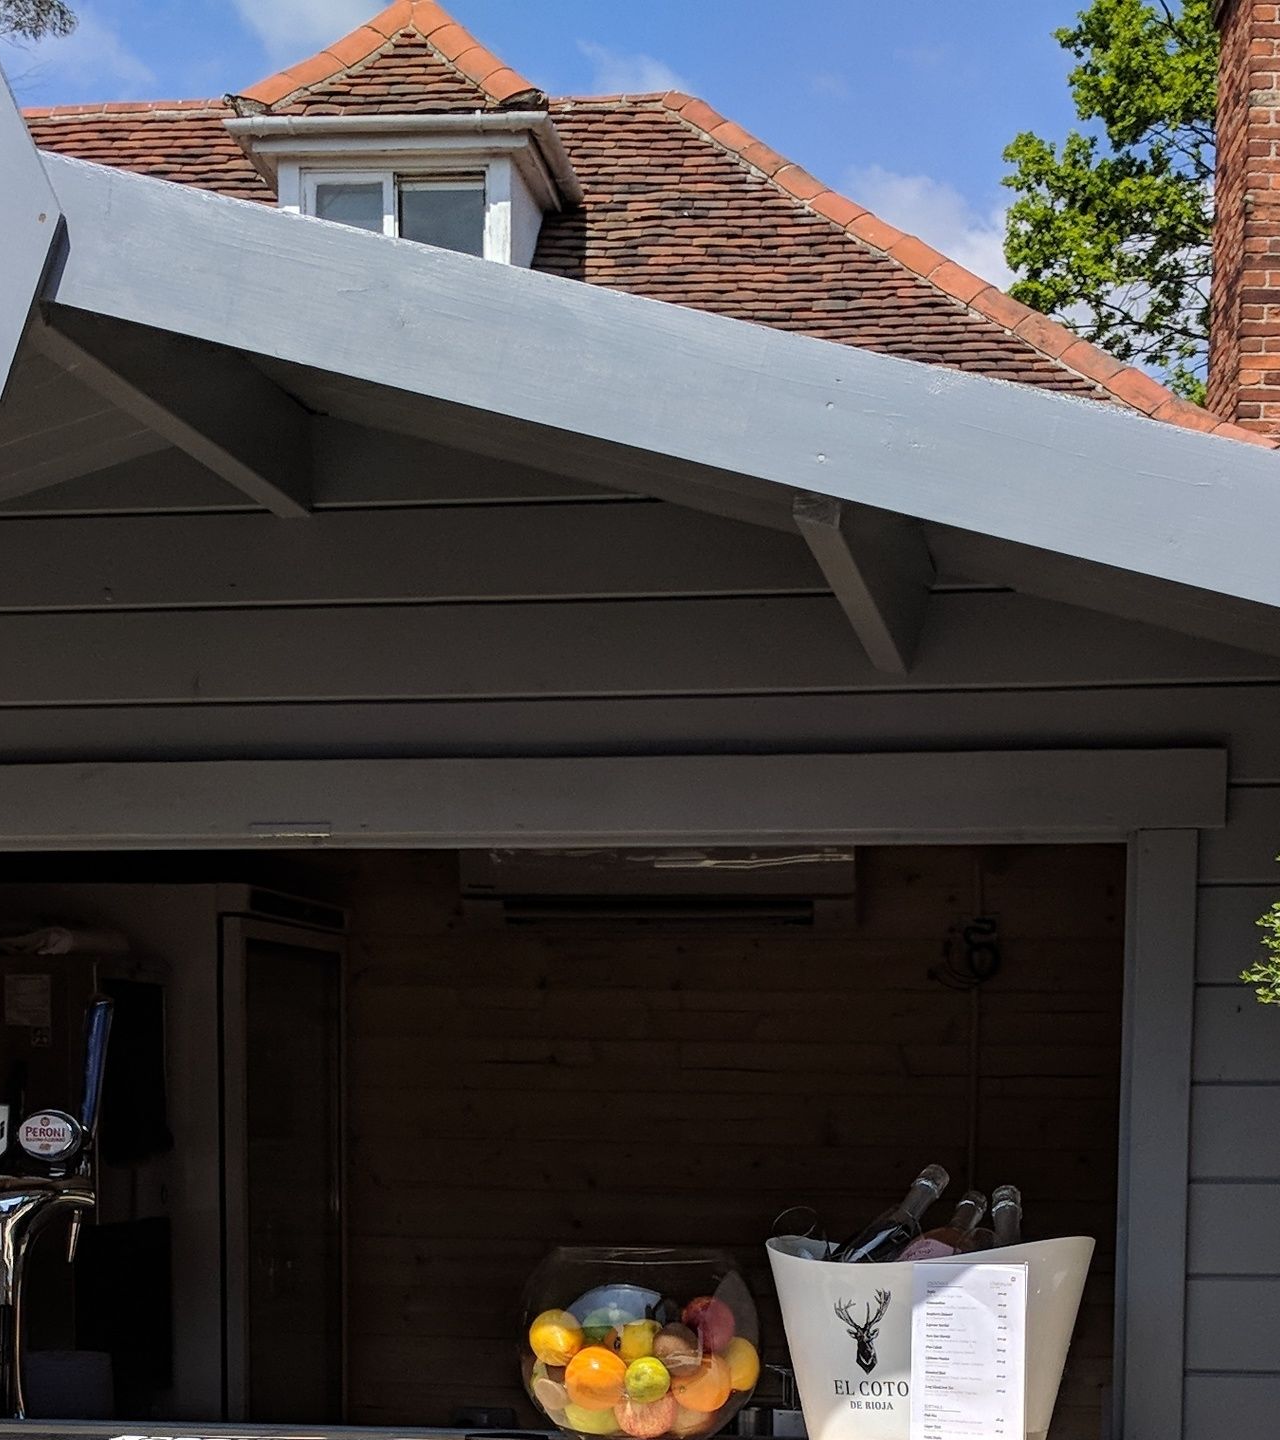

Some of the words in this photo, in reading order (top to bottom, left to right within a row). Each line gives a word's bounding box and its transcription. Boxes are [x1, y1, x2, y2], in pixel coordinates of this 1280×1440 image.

[25, 1126, 66, 1138] PERONI
[833, 1379, 855, 1396] EL
[859, 1380, 909, 1397] COTO
[850, 1400, 863, 1410] DE
[865, 1401, 894, 1410] RIOJA
